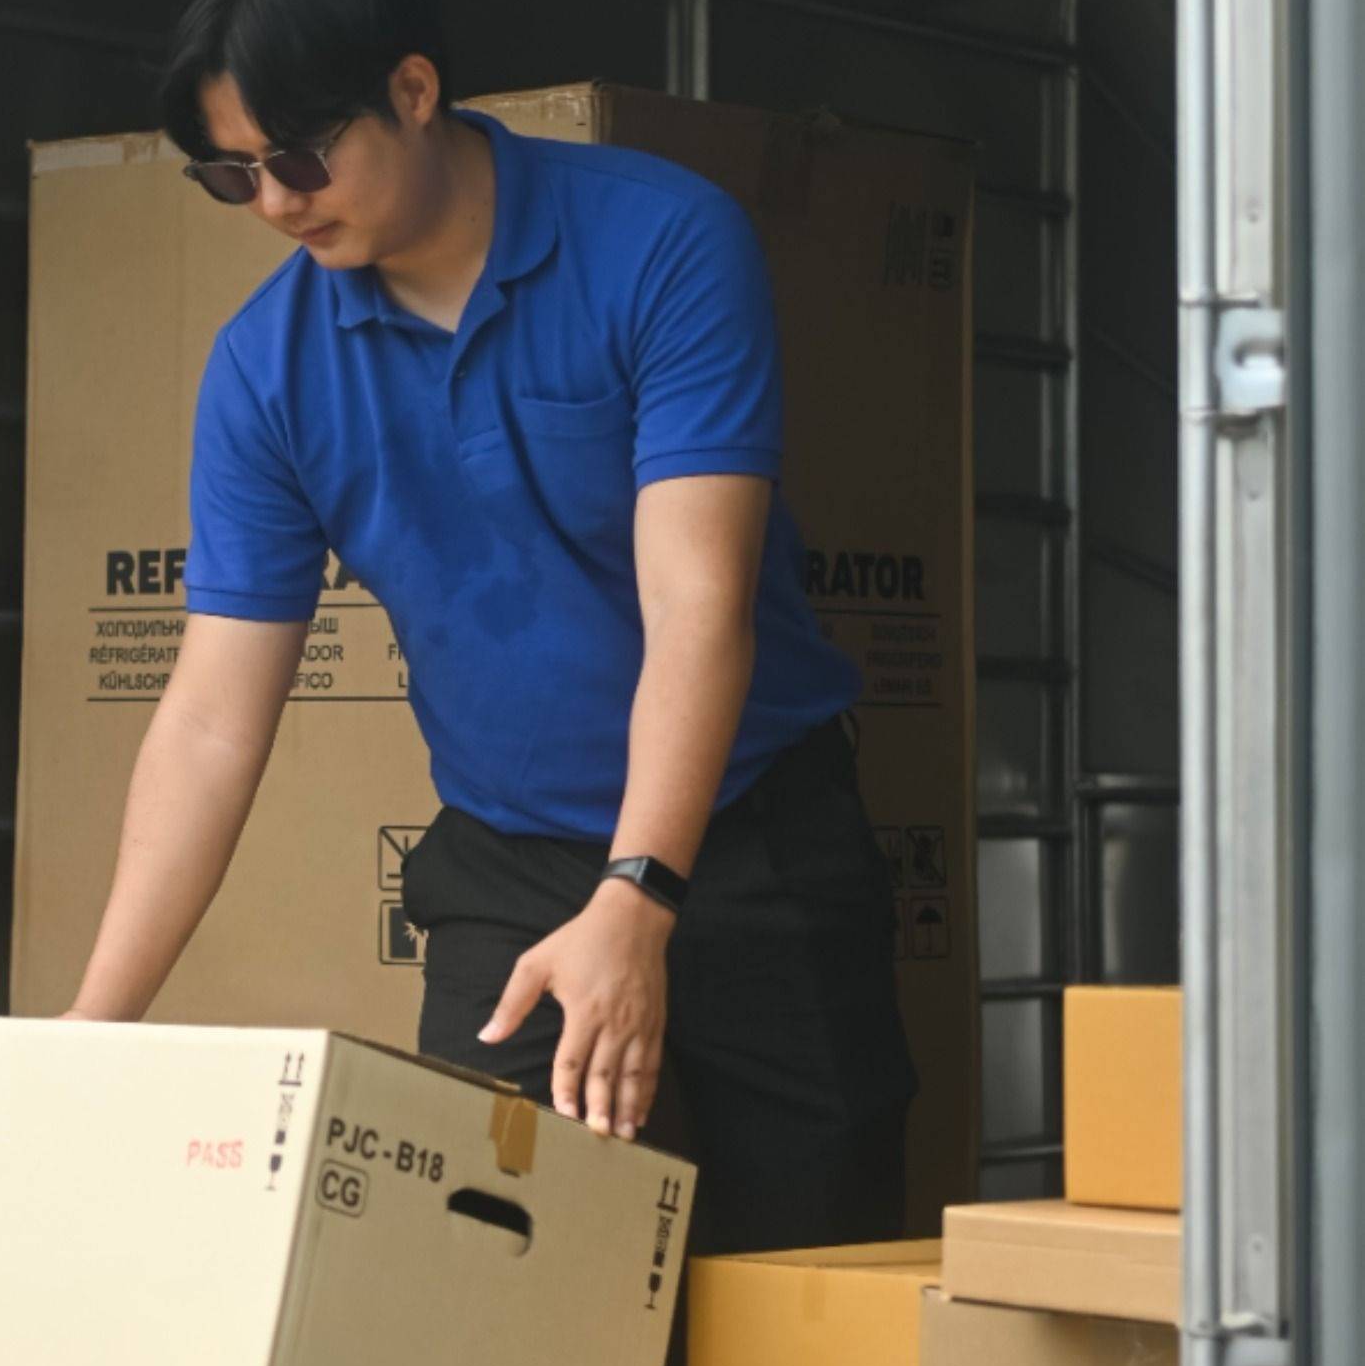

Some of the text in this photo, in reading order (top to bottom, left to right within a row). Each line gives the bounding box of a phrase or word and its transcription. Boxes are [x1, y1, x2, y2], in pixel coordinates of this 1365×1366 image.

[106, 549, 187, 595] REF
[806, 549, 925, 601] RATOR
[186, 1138, 244, 1169] PASS
[321, 1169, 361, 1208] CG
